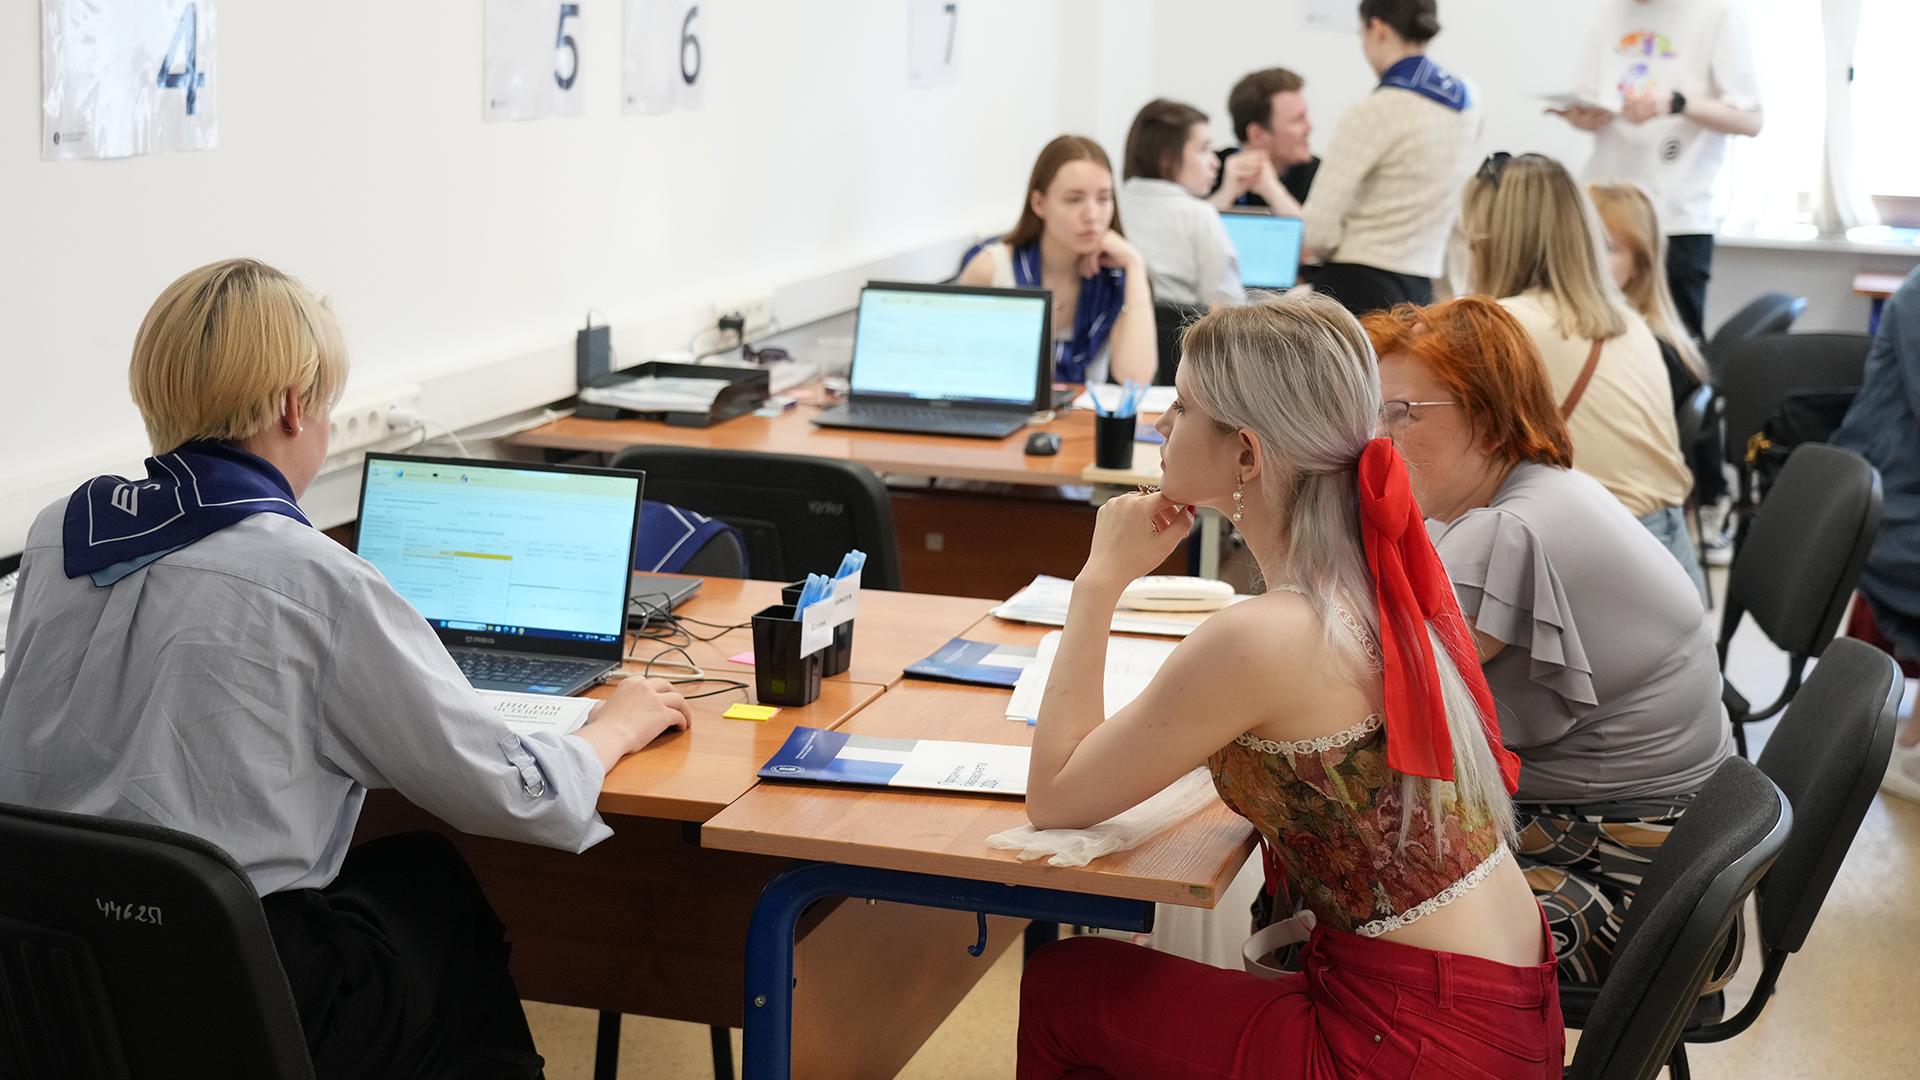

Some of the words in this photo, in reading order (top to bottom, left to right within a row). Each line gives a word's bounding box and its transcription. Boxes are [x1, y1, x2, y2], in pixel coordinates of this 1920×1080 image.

[155, 1, 206, 117] 4
[553, 2, 581, 91] 5
[679, 5, 703, 86] 6
[943, 2, 958, 66] 7
